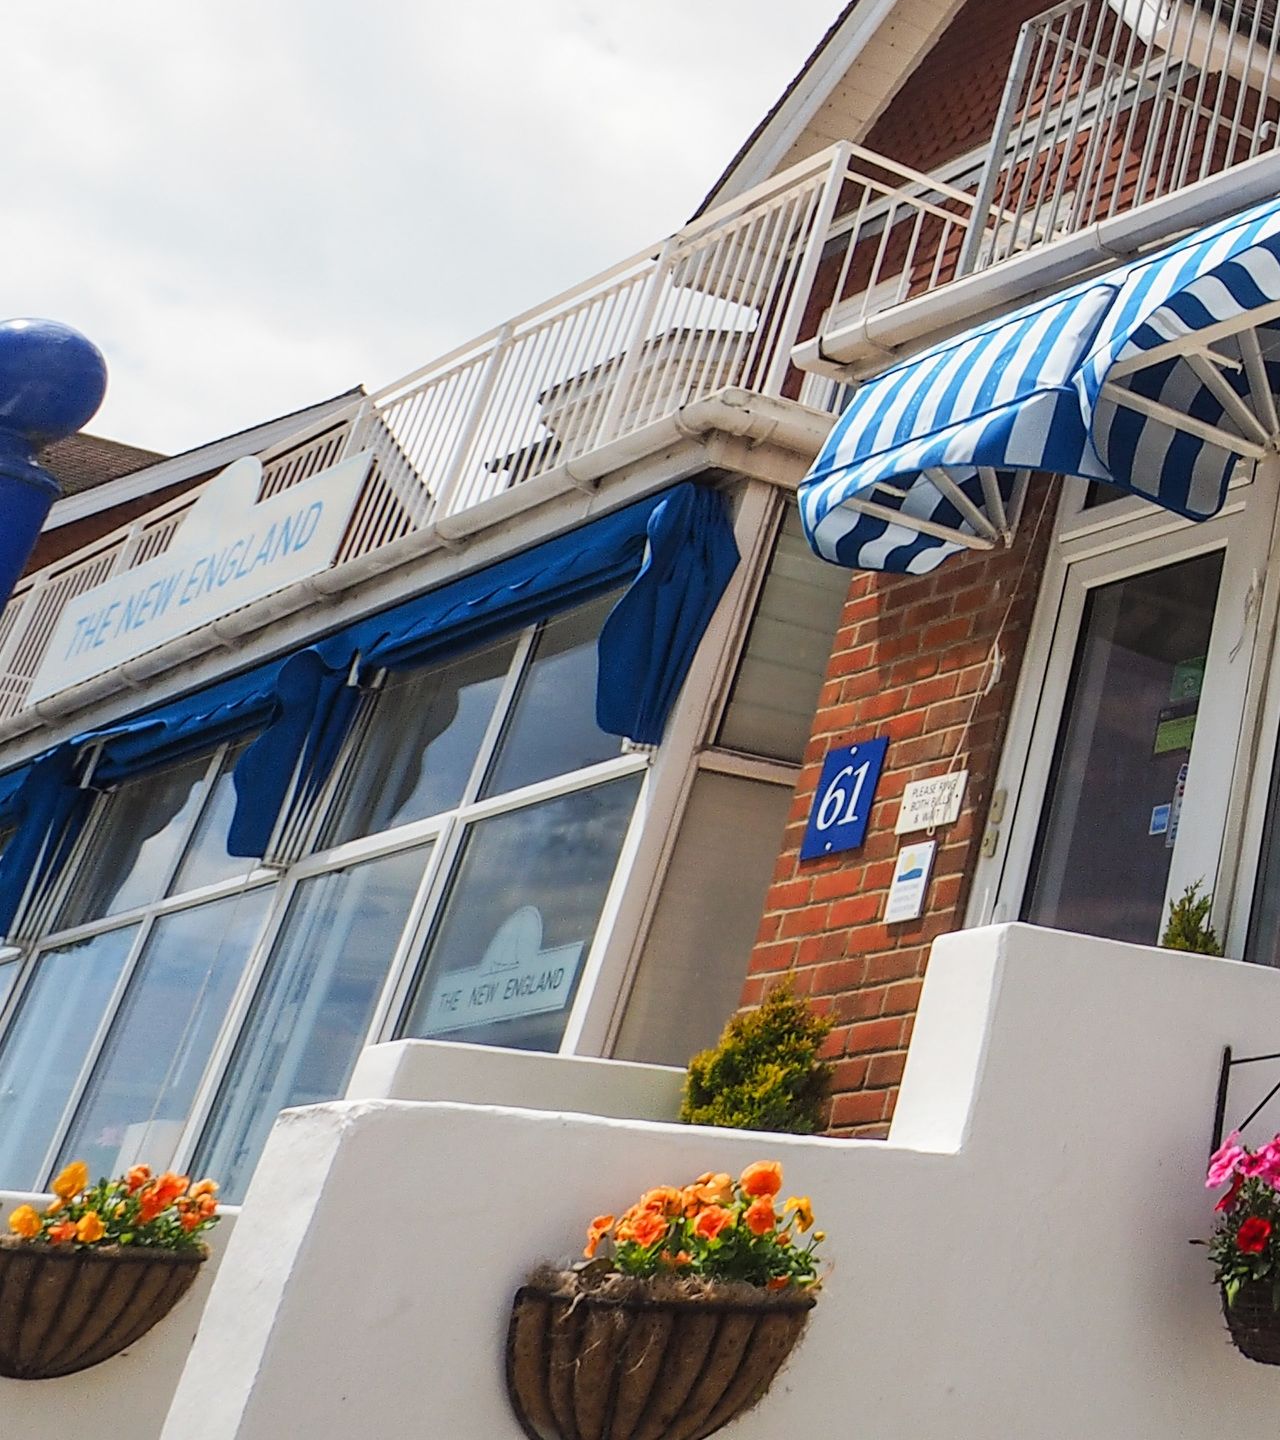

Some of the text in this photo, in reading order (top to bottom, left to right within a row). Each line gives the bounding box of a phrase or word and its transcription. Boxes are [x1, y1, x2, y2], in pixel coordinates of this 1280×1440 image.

[65, 500, 323, 660] THE NEW ENGLAND
[816, 760, 870, 831] 61
[912, 783, 937, 798] PLEASE
[439, 968, 565, 1011] THE NEW ENGLAND
